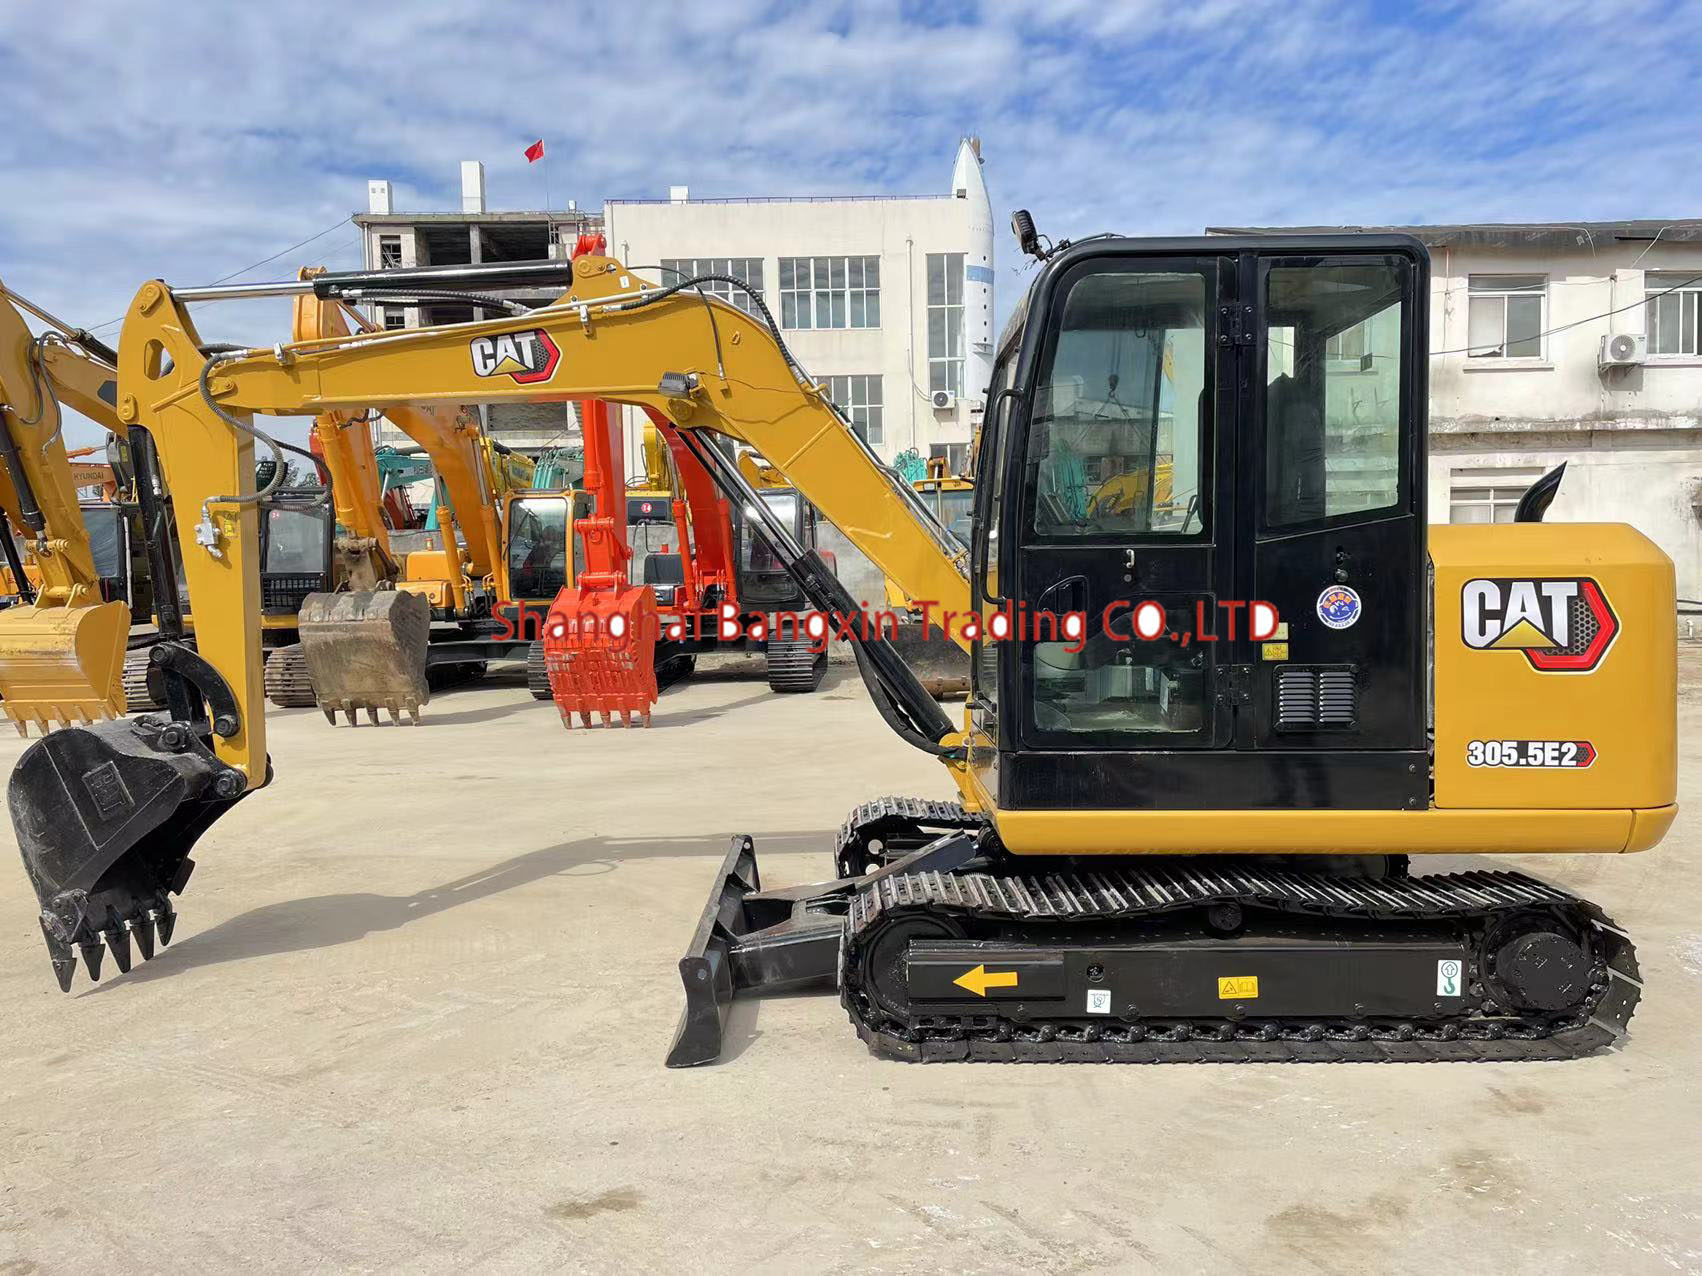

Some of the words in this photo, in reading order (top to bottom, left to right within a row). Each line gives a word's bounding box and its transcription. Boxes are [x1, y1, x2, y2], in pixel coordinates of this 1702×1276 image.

[471, 331, 536, 376] CAT
[73, 471, 104, 480] HYUNDAI
[1463, 580, 1578, 647] CAT
[1468, 741, 1578, 765] 305.5E2
